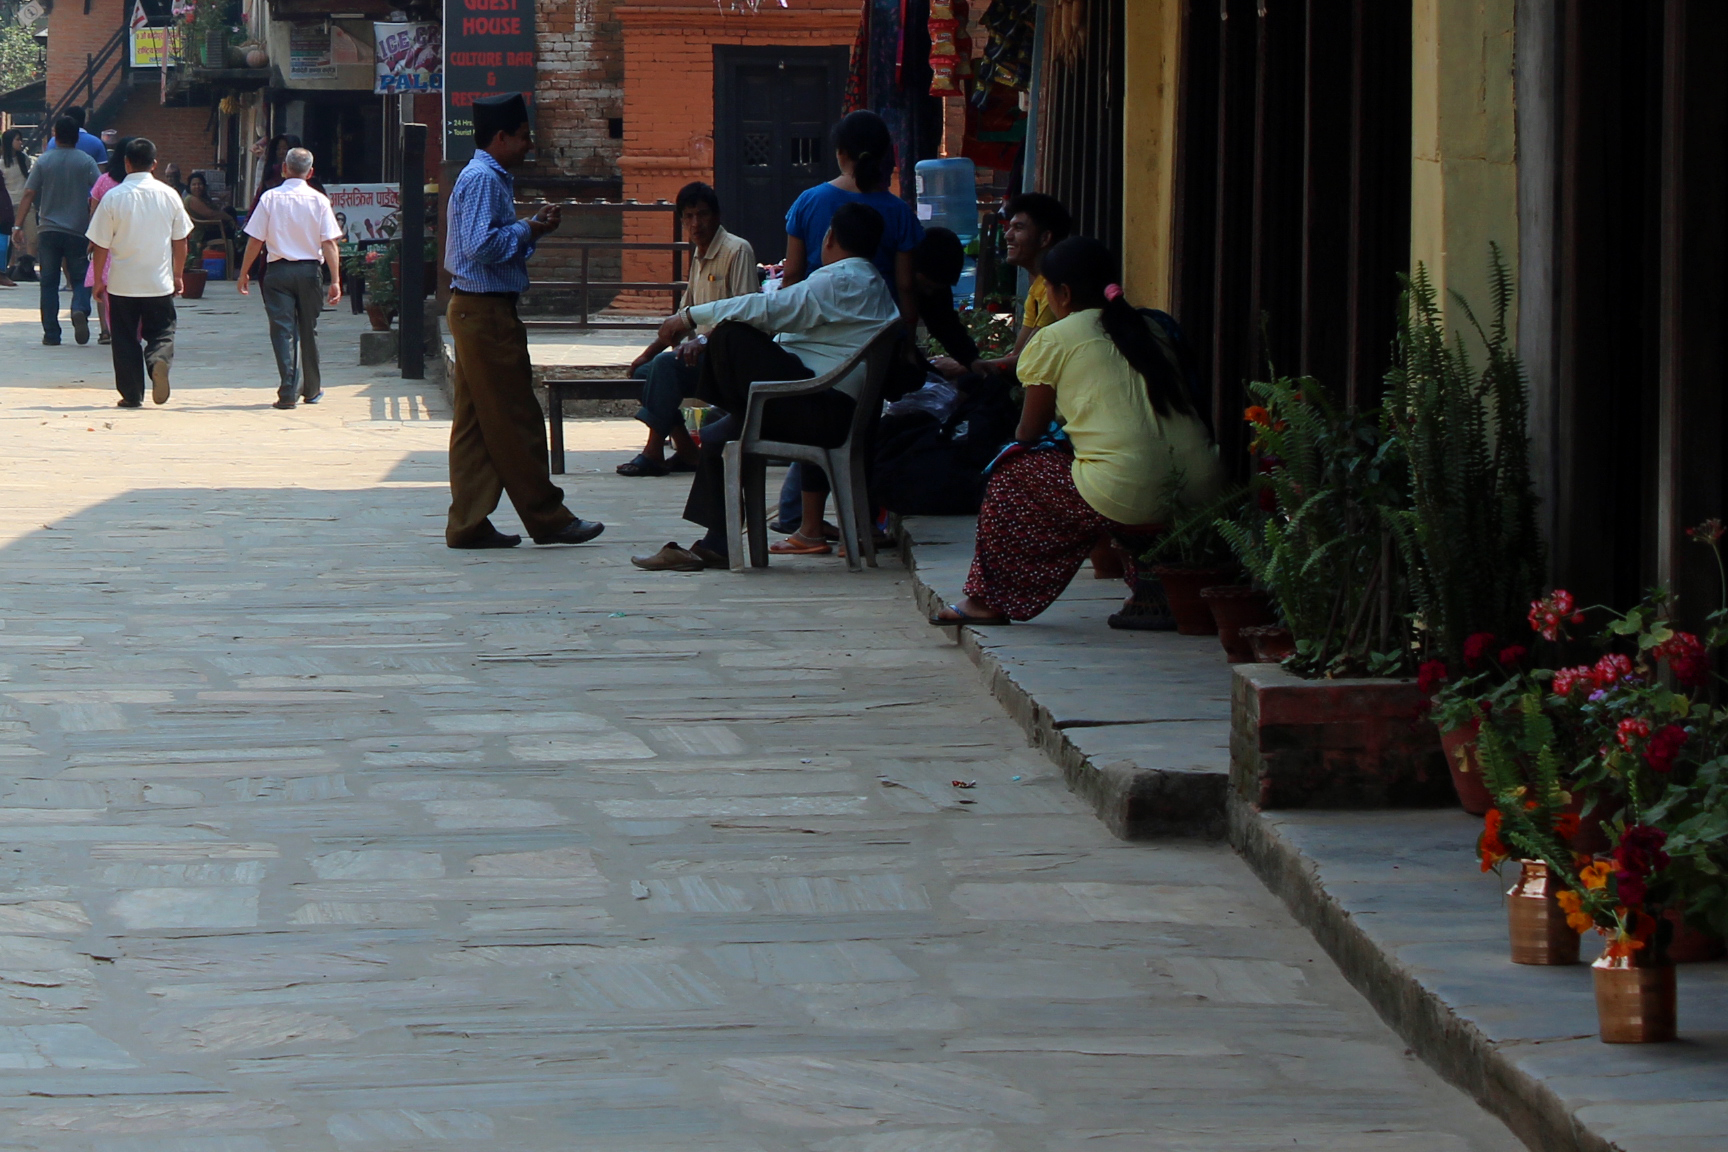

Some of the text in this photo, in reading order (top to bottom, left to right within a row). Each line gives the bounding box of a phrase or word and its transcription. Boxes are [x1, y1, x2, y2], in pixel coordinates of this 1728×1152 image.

[462, 17, 522, 36] HOUSE
[378, 25, 442, 60] ICE CR
[450, 51, 535, 67] CULTURE BAR
[486, 71, 497, 87] &
